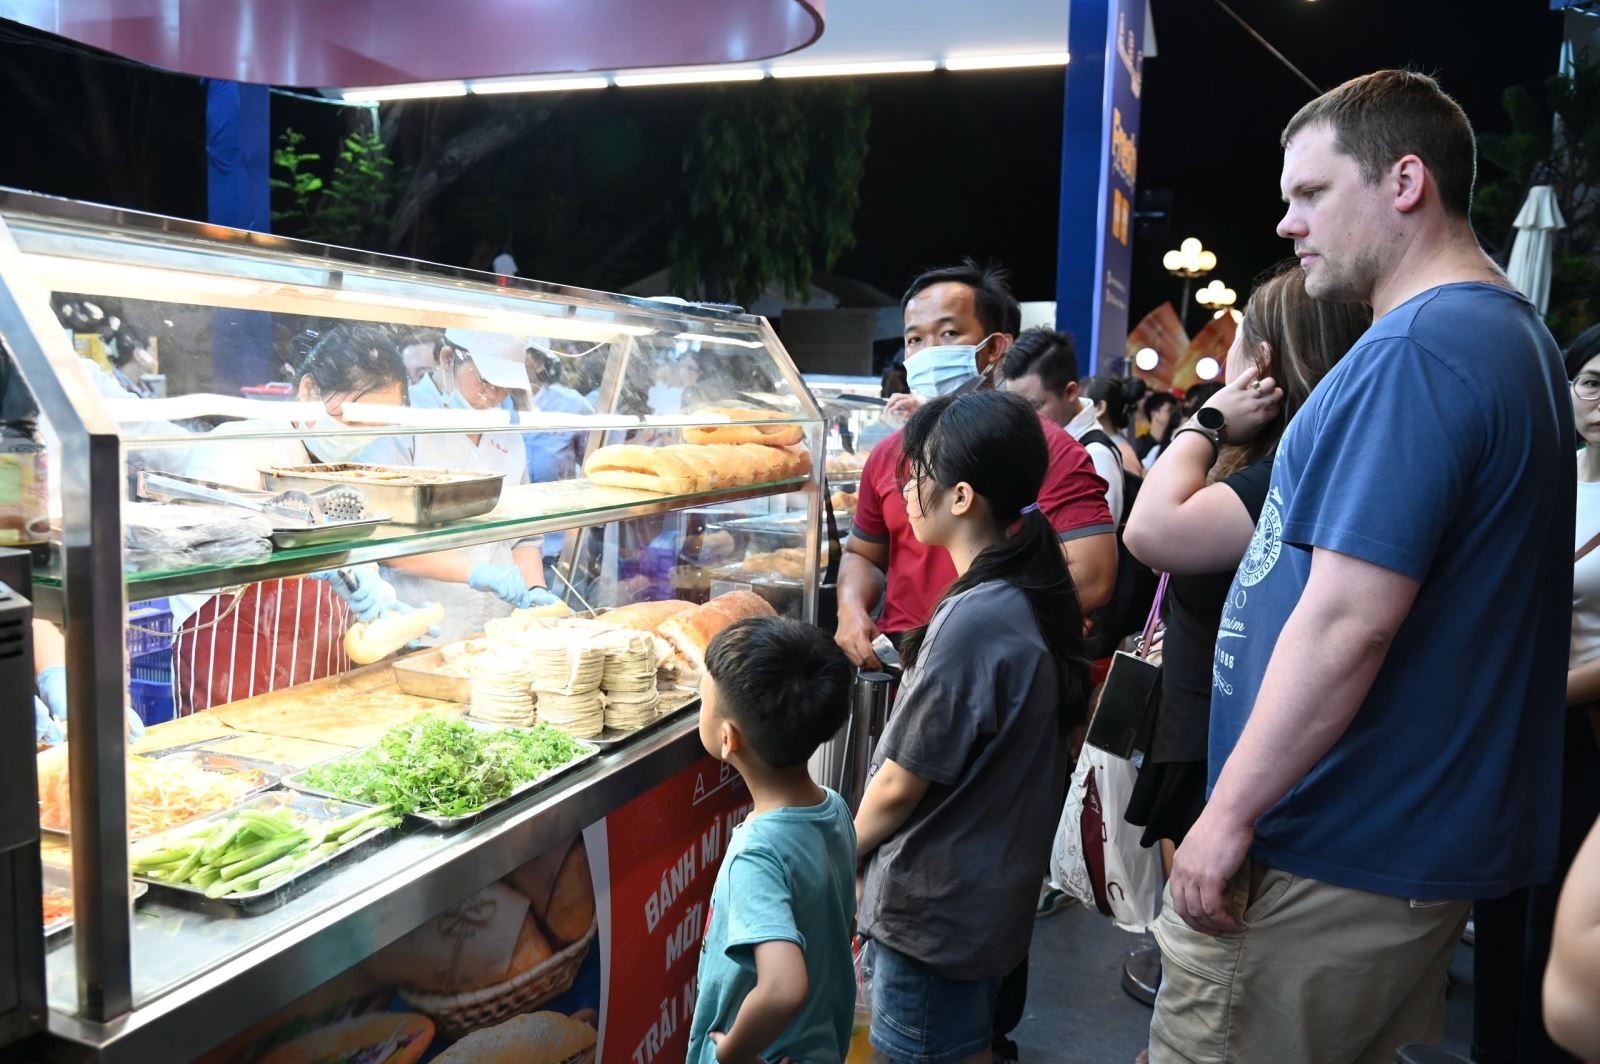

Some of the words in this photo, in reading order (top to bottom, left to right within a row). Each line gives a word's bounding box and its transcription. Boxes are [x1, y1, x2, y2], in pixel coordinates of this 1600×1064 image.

[1217, 648, 1235, 670] 1986
[645, 844, 695, 935] BÁNH
[701, 816, 721, 871] MÌ
[632, 997, 677, 1064] TRẢI
